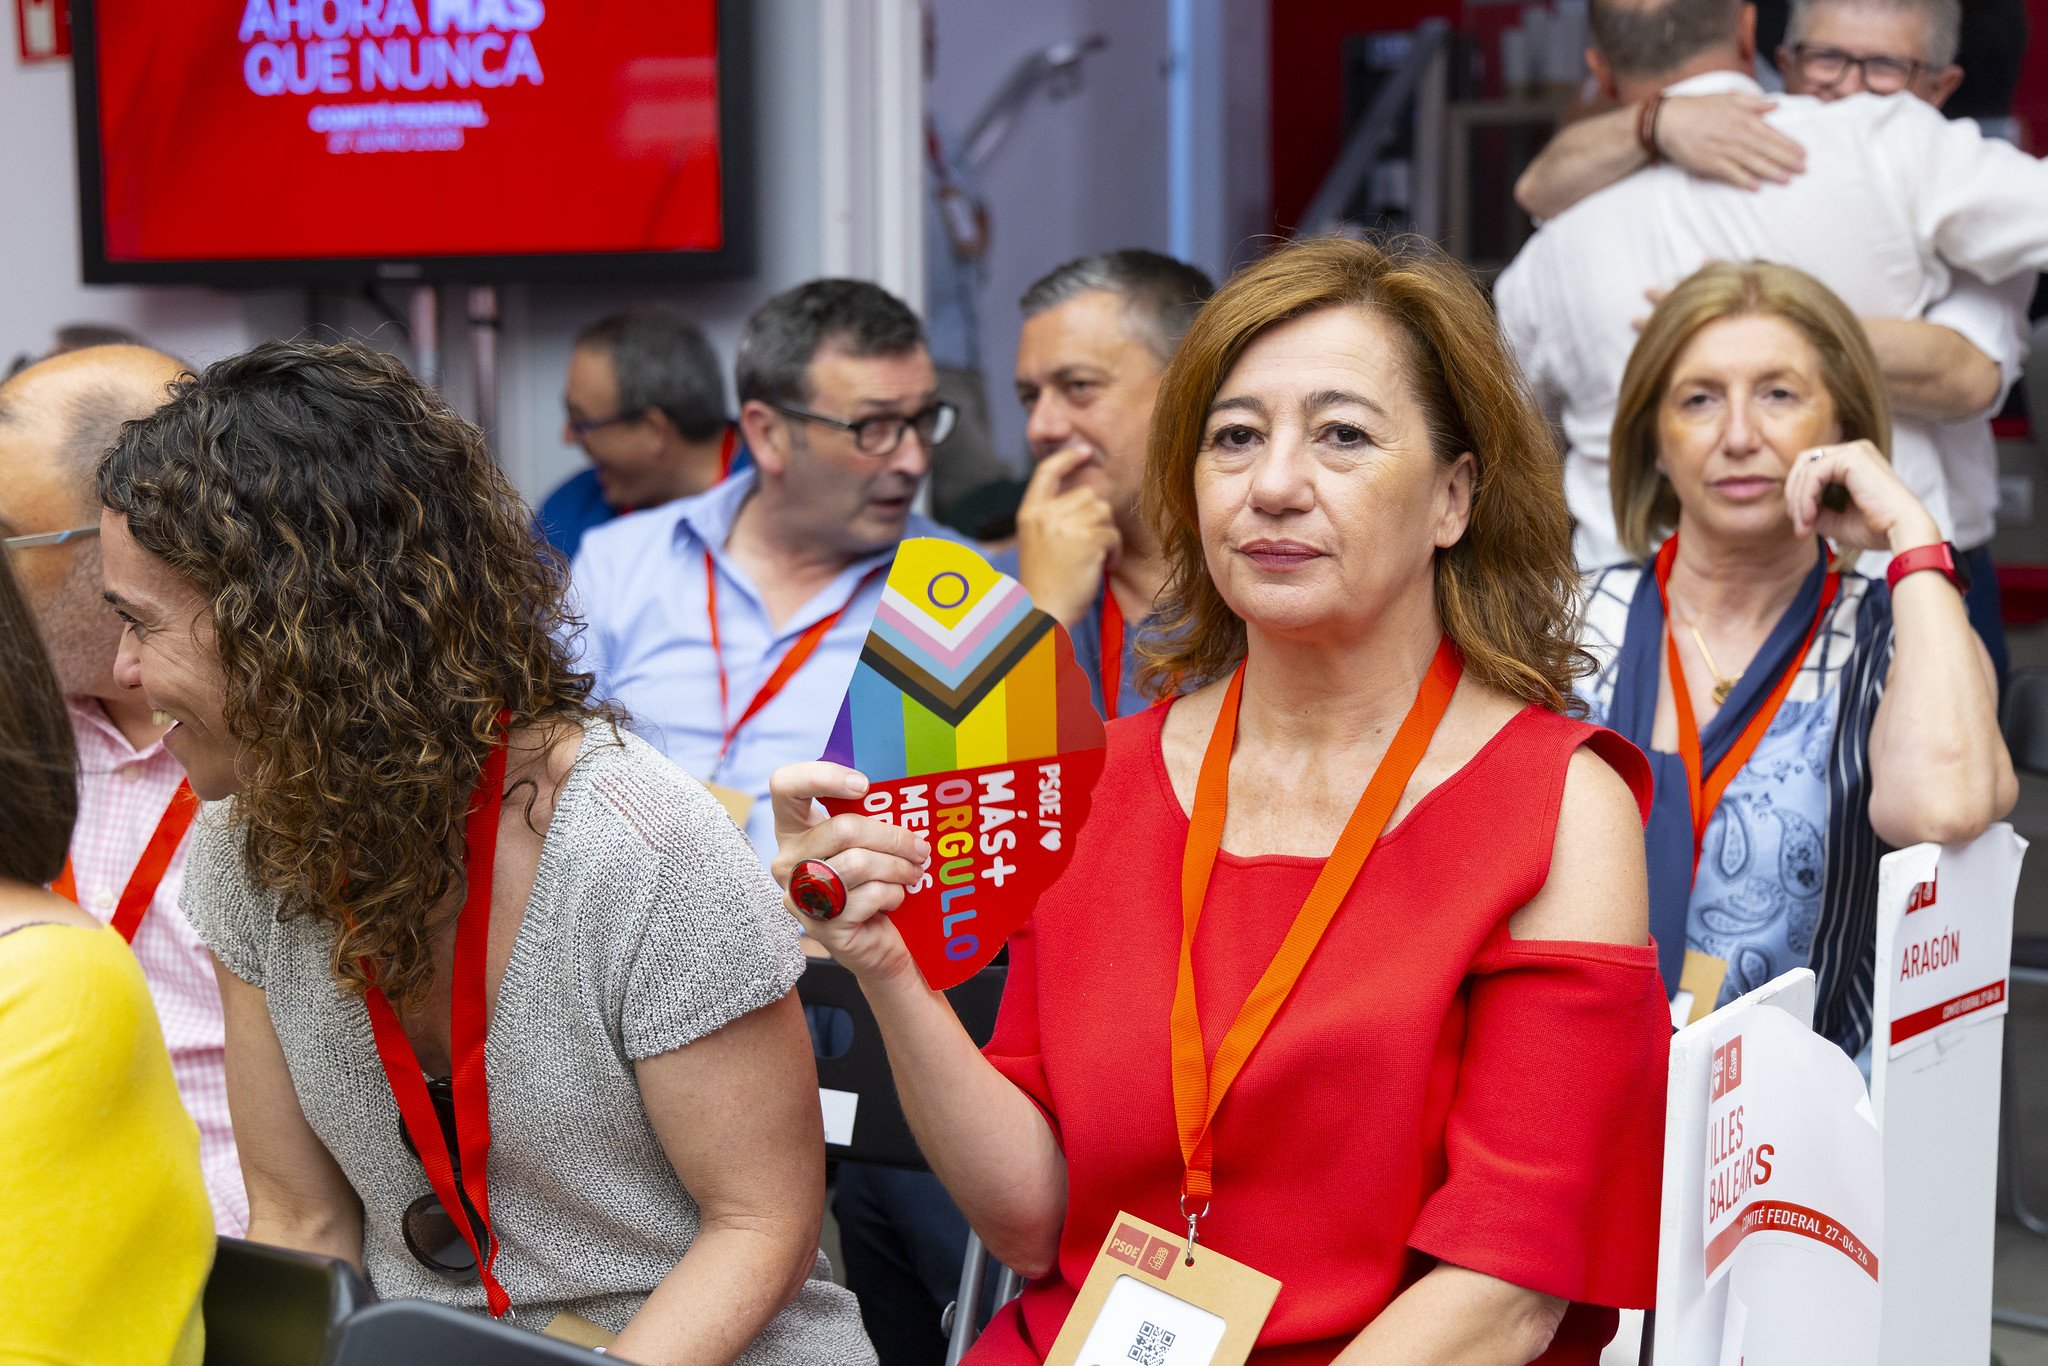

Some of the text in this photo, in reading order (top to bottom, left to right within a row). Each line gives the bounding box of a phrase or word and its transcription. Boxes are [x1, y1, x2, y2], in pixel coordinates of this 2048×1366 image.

[238, 0, 422, 42] AHORA
[243, 31, 545, 96] QUE NUNCA
[899, 784, 933, 894] MES
[935, 779, 979, 961] ORGULLO
[1900, 925, 1960, 982] ARAGÓN
[1710, 1105, 1744, 1170] ILLES
[1709, 1143, 1775, 1225] BALEARS
[1111, 1238, 1140, 1259] PSOE
[1766, 1208, 1821, 1235] FEDERAL
[1825, 1224, 1868, 1266] 27-06-26
